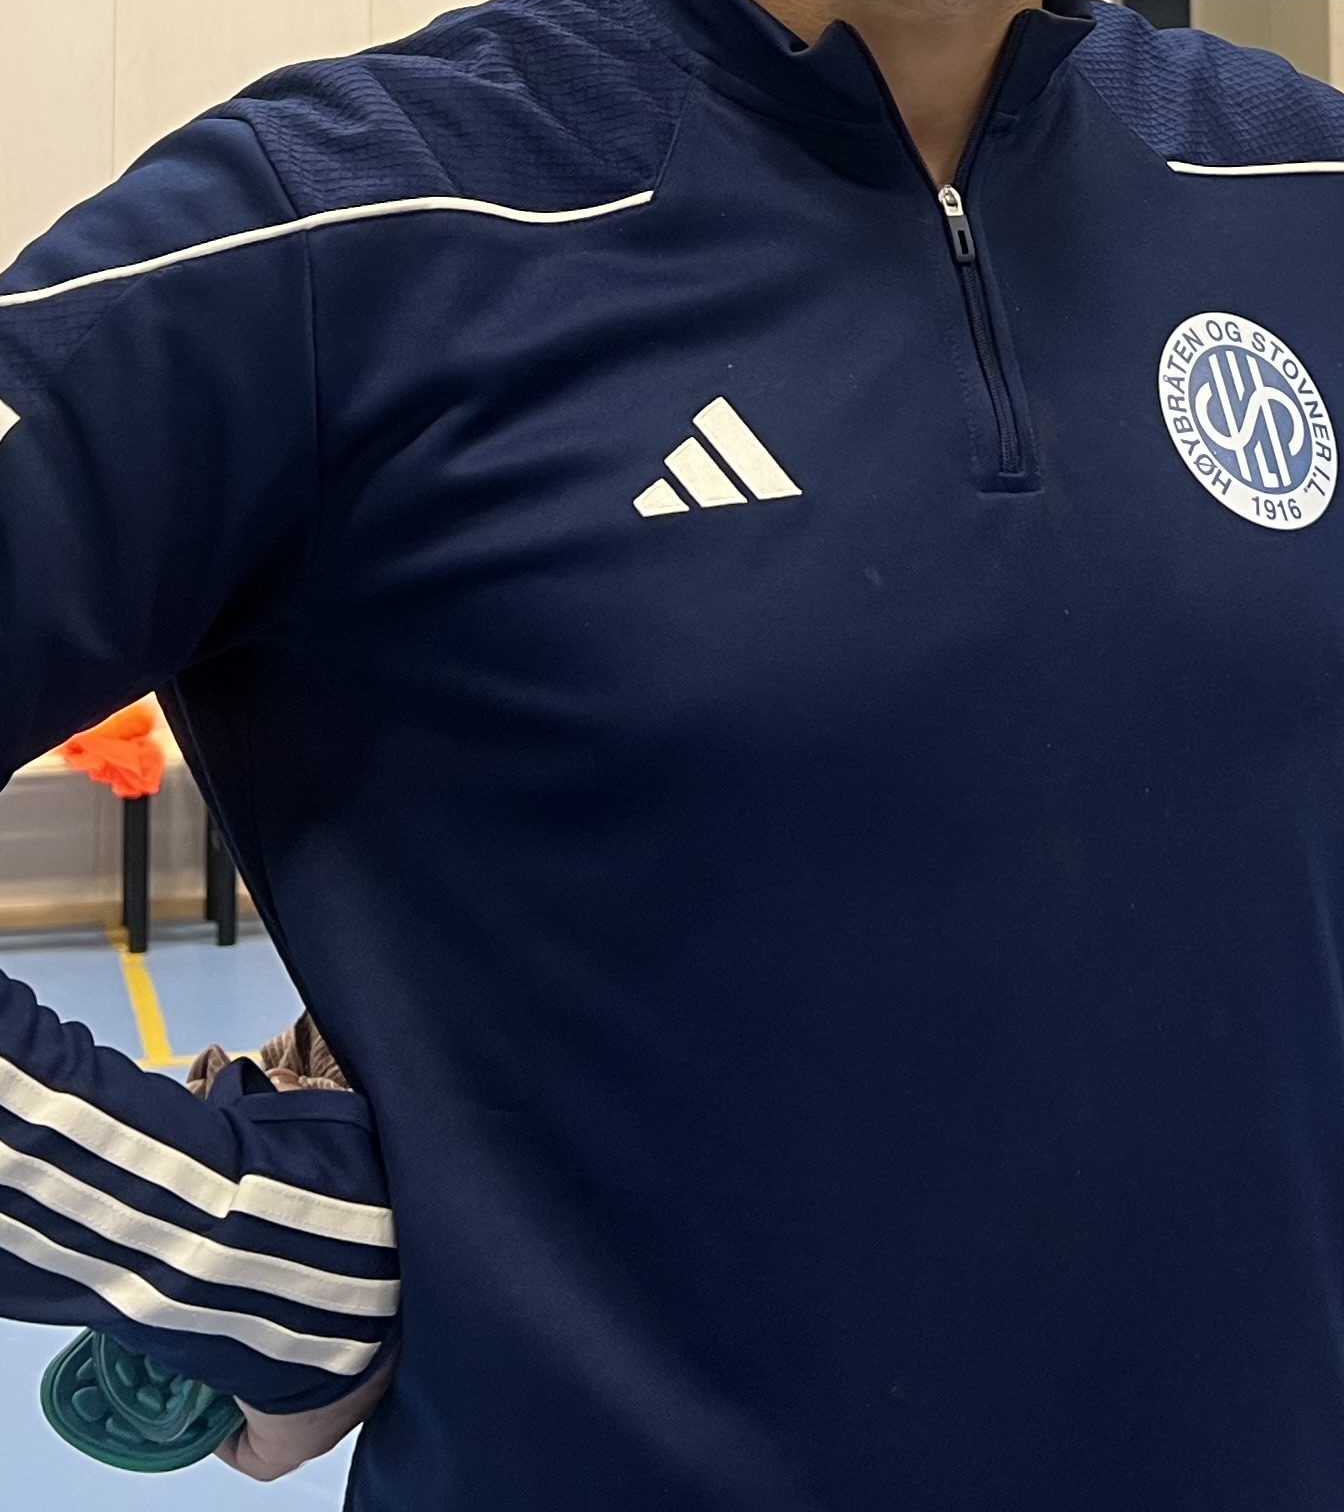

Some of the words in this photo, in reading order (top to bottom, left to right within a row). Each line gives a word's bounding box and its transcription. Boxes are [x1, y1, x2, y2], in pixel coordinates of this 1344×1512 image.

[1162, 327, 1233, 495] HØYBRÅTEN
[1205, 319, 1242, 343] OG
[1251, 331, 1332, 462] STOVNER
[1251, 495, 1302, 522] 1916
